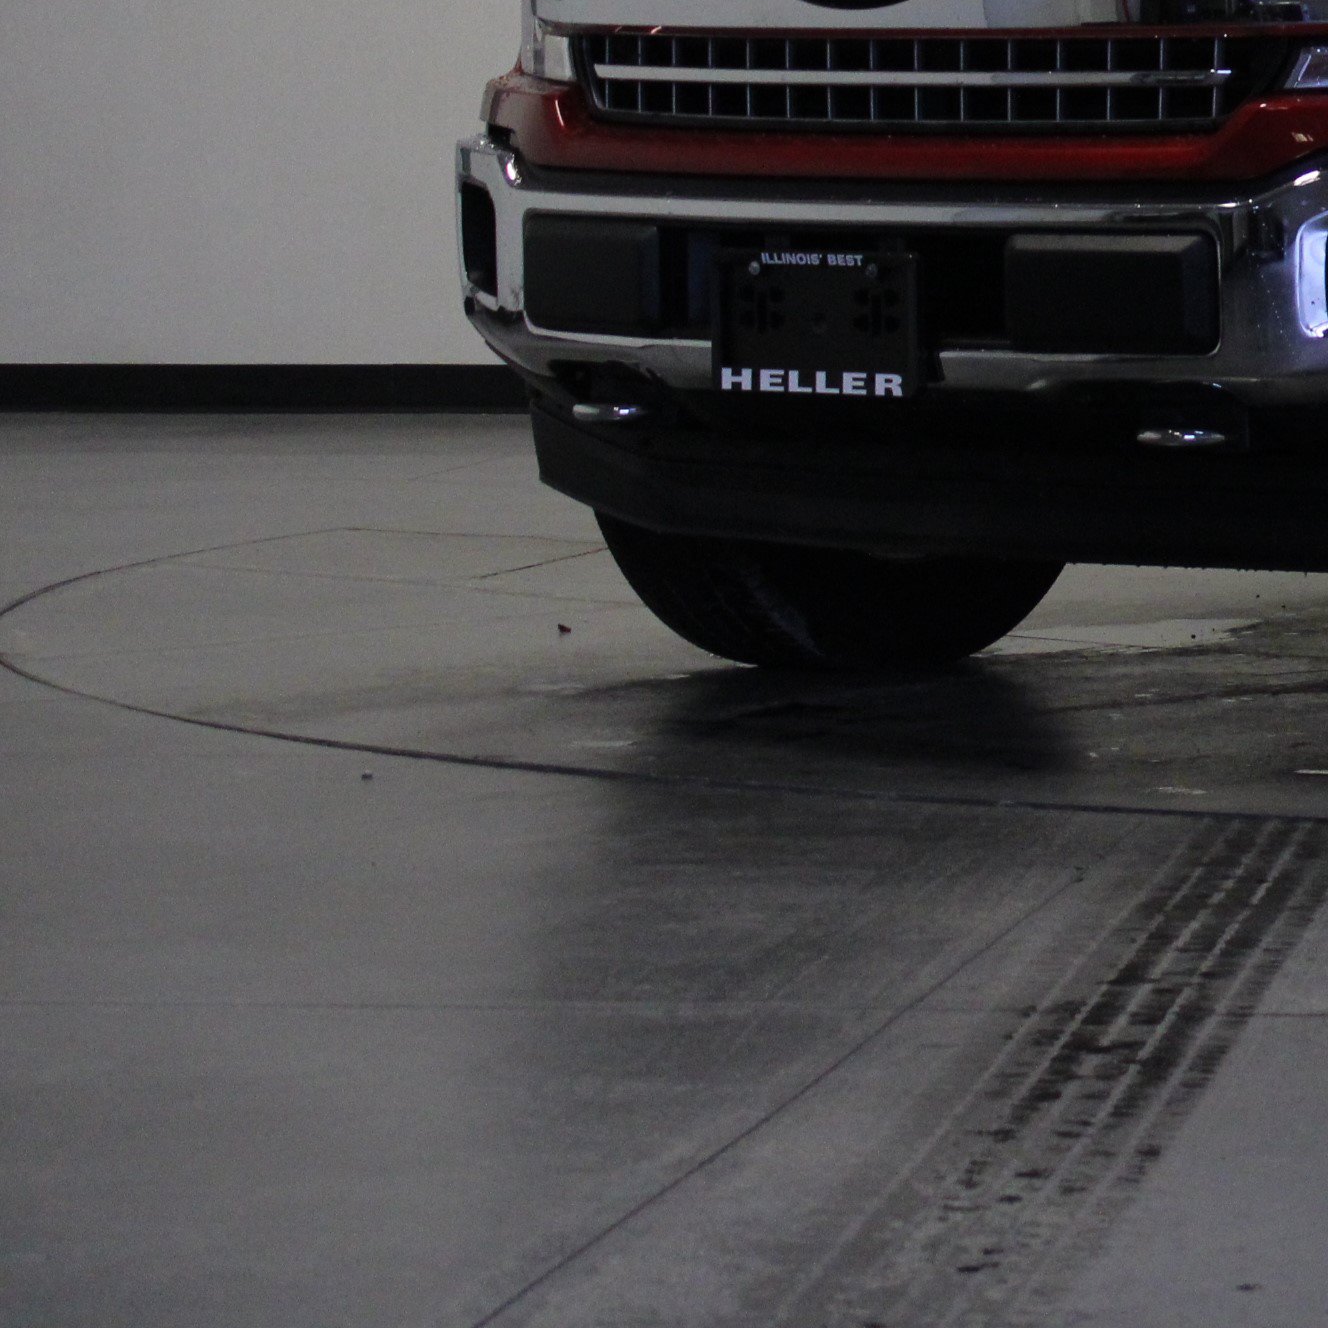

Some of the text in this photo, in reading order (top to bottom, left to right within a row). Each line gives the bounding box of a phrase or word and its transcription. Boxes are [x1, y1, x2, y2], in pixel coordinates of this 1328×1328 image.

[760, 252, 863, 267] ILLINOIS' BEST
[721, 367, 904, 398] HELLER
